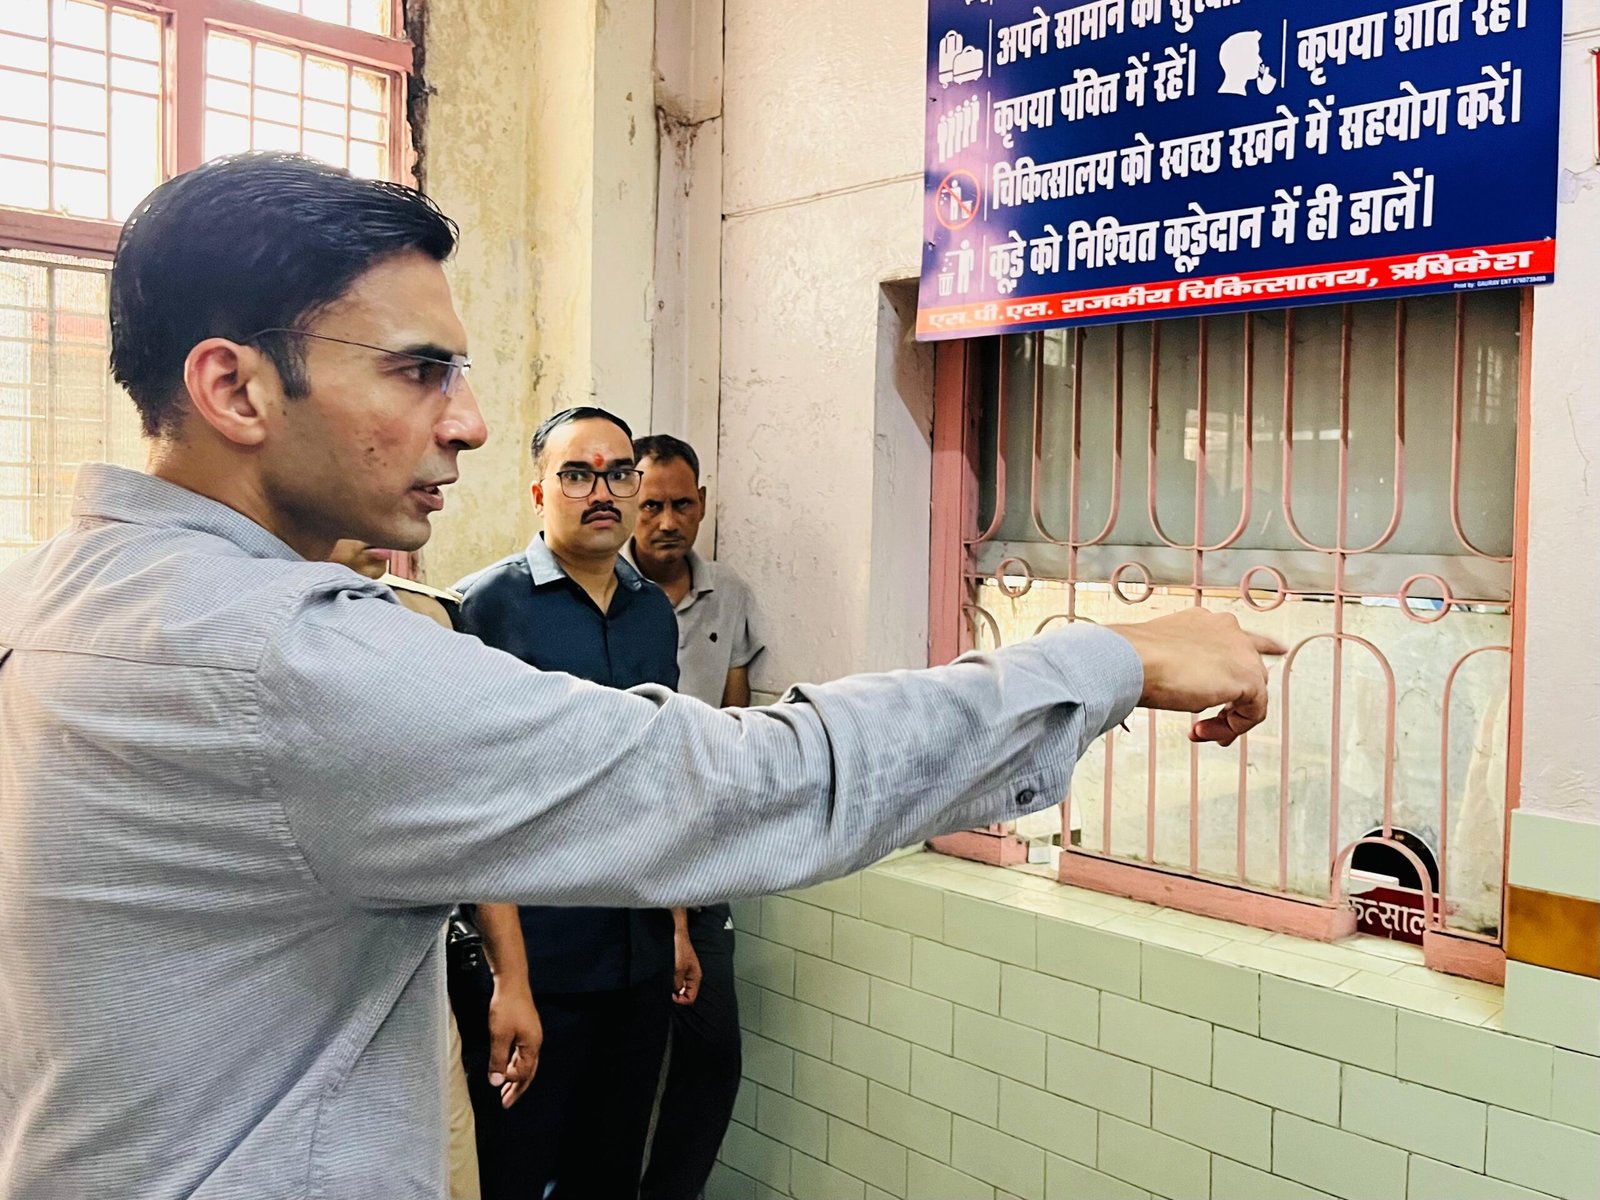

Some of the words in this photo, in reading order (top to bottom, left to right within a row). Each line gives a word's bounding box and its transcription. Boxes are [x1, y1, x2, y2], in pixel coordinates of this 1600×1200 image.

[996, 6, 1050, 65] अपने
[1054, 0, 1125, 50] सामान
[1296, 11, 1388, 86] कृपया
[992, 155, 1117, 210] चिकित्सालय
[1120, 131, 1155, 186] को
[1159, 130, 1225, 181] स्वच्छ
[1229, 104, 1299, 169] रखने
[1305, 94, 1335, 155] में
[1338, 80, 1451, 151] सहयोग
[1456, 60, 1522, 130] करें।
[993, 88, 1055, 149] कृपया
[1060, 67, 1120, 122] पंक्ति
[1125, 52, 1150, 108] में
[1153, 42, 1196, 103] रहें।
[1029, 223, 1062, 275] को
[1068, 215, 1160, 272] निश्चित
[1271, 185, 1303, 245] में
[1306, 183, 1343, 241] ही
[1349, 167, 1435, 237] डालें।
[1061, 287, 1173, 313] राजकीय
[1178, 267, 1379, 301] चिकित्सालय,
[1388, 249, 1534, 281] ऋषिकेश
